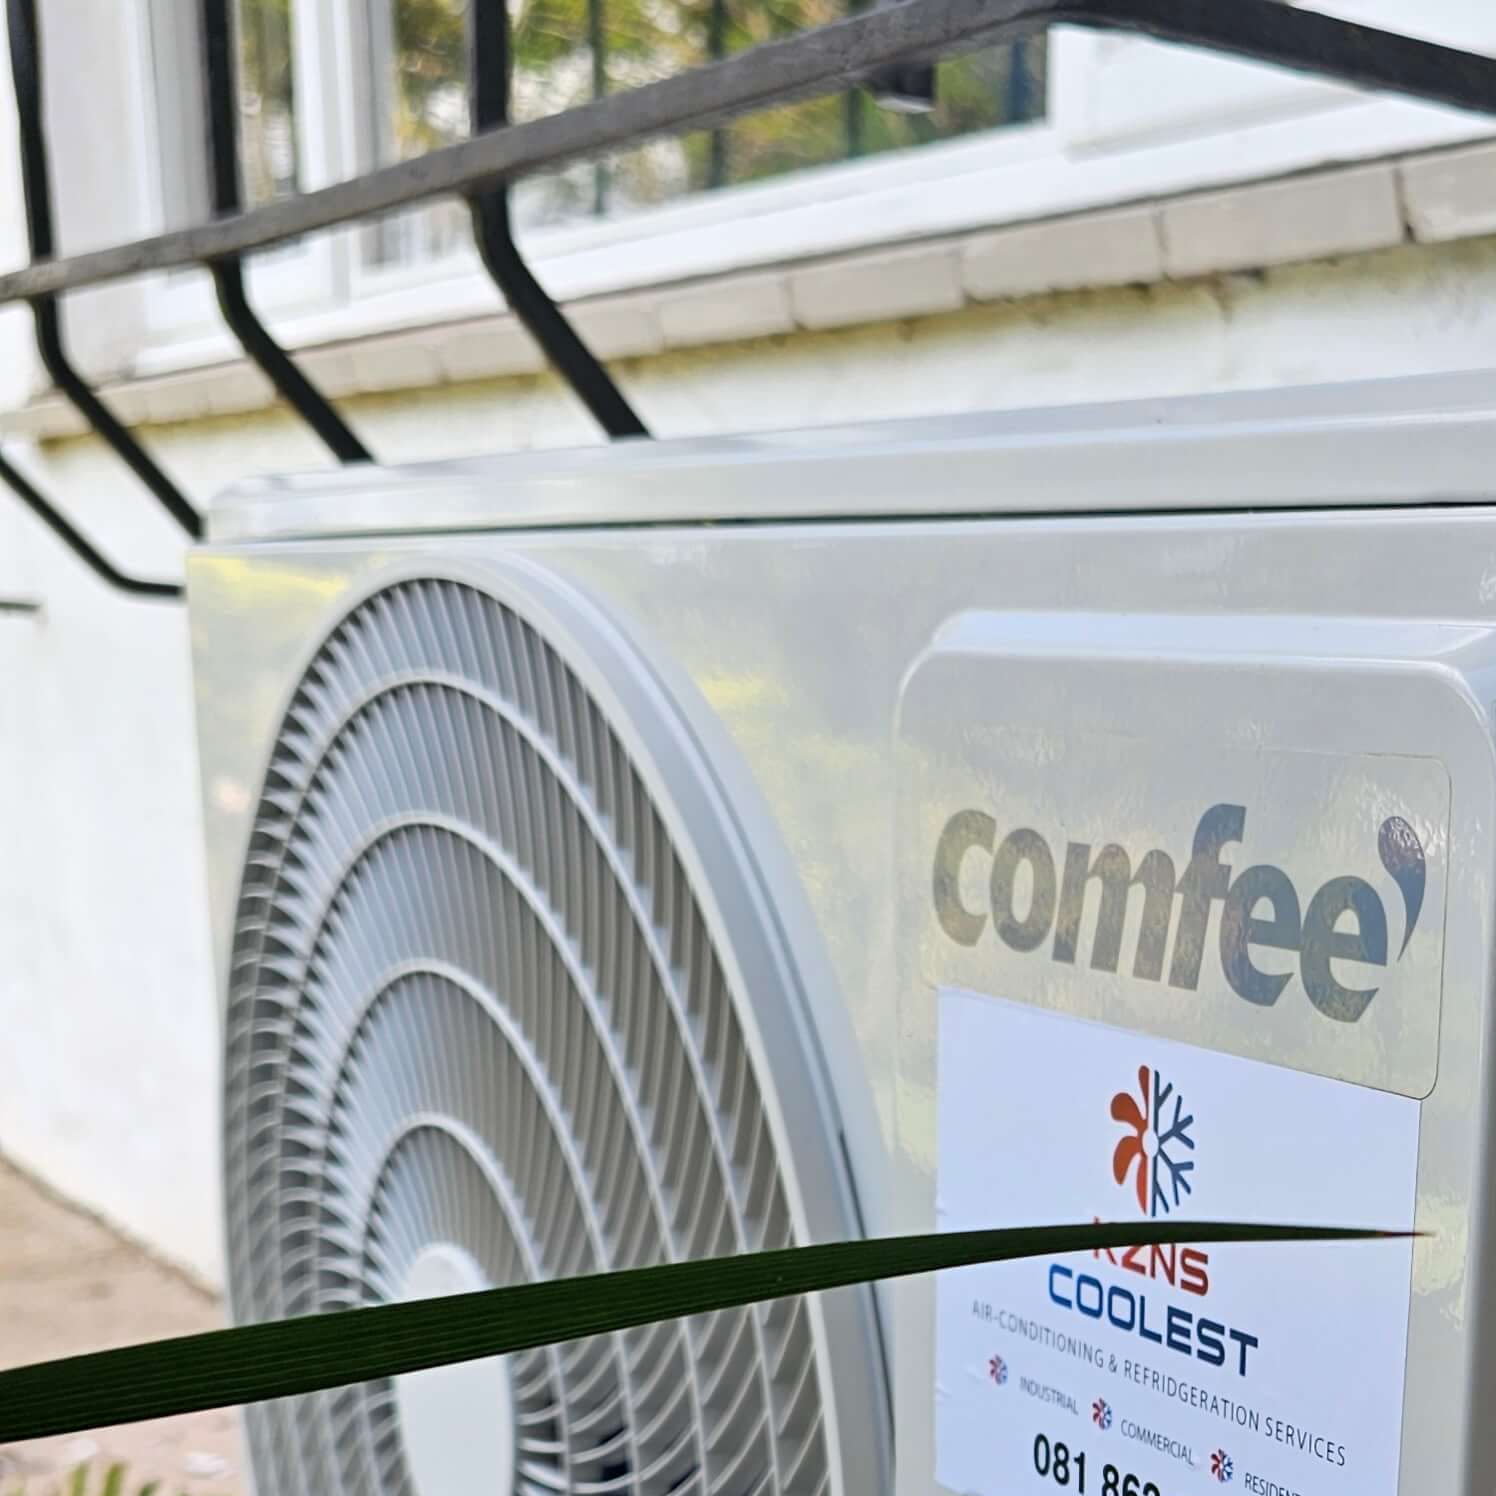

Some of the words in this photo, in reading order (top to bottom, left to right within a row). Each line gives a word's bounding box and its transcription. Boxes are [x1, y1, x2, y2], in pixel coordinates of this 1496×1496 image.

[1049, 1263, 1259, 1377] COOLEST
[970, 1299, 1105, 1369] AIR-CONDITIONING
[1108, 1354, 1119, 1374] &
[1123, 1359, 1261, 1432] REFRIDGERATION
[1264, 1416, 1347, 1467] SERVICES
[1019, 1375, 1080, 1415] INDUSTRIAL
[1120, 1418, 1195, 1466] COMMERCIAL
[1033, 1433, 1087, 1495] 081
